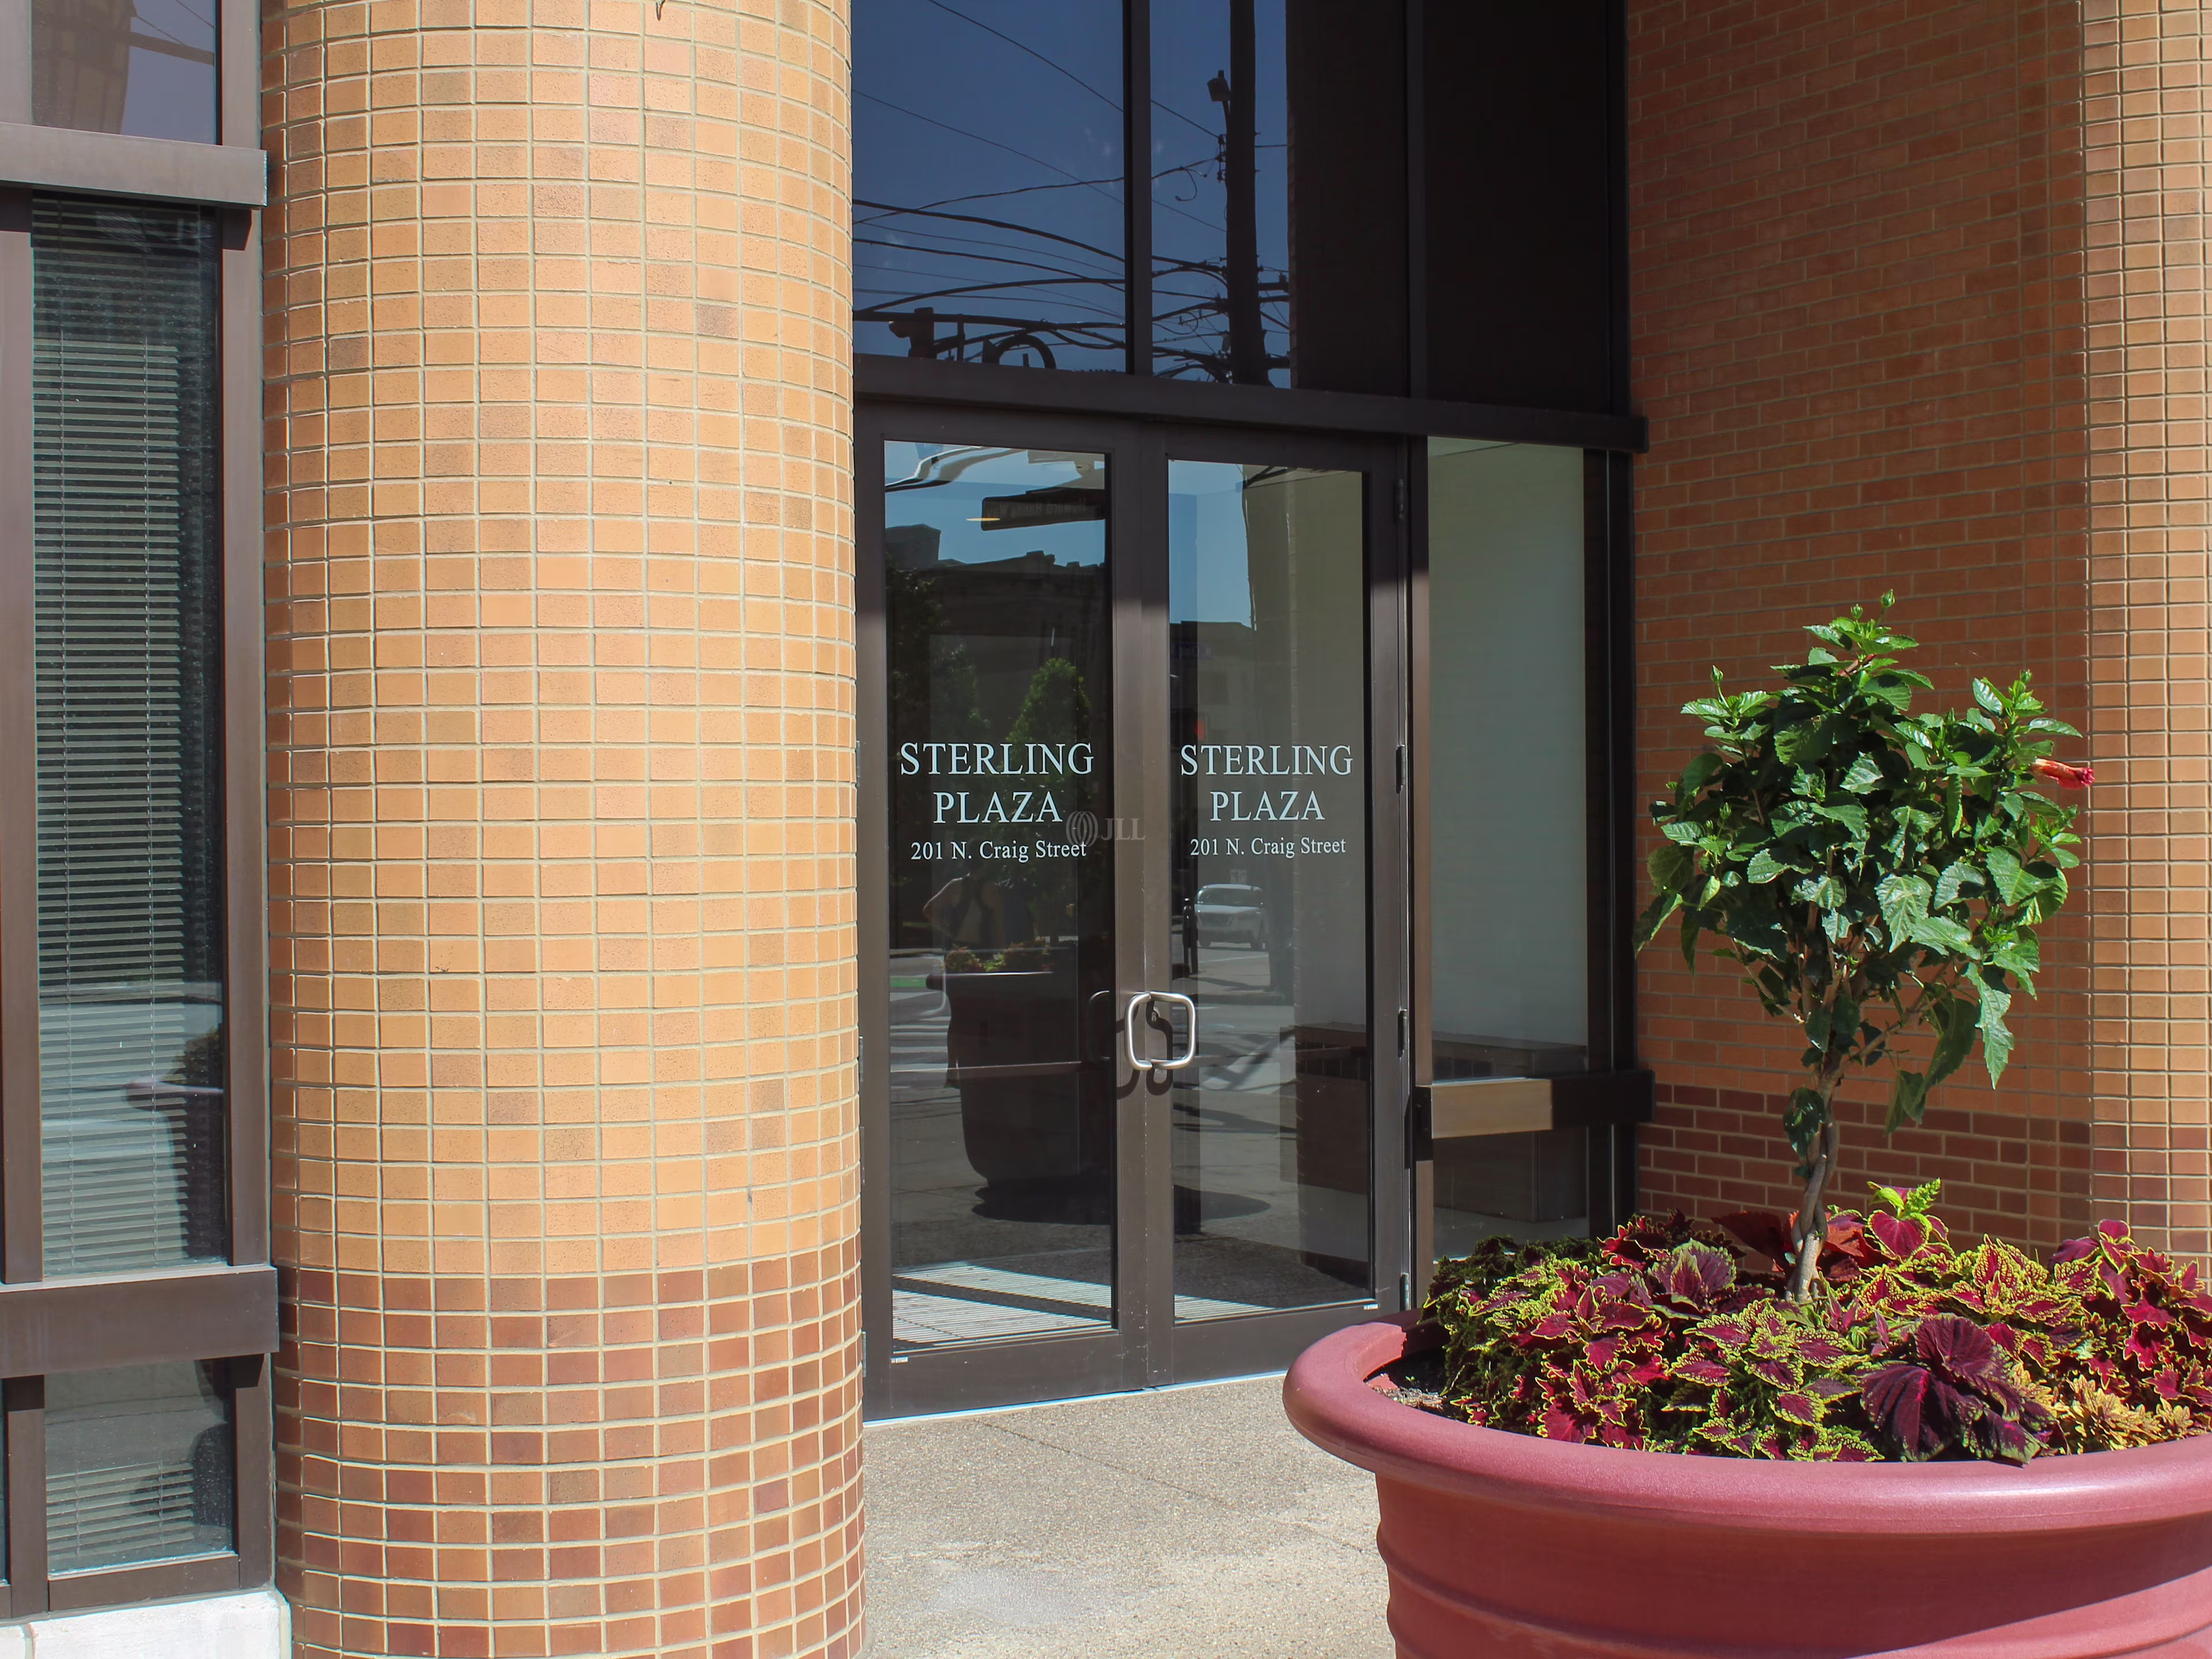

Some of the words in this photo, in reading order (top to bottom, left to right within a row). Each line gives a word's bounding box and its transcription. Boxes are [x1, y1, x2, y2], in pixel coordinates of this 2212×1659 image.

[901, 743, 1094, 775] STERLING
[1181, 744, 1354, 776] STERLING
[933, 791, 1063, 824] PLAZA
[1210, 790, 1326, 822] PLAZA
[911, 842, 943, 861] 201
[950, 841, 973, 860] N.
[979, 840, 1029, 863] Craig
[1036, 840, 1087, 859] Street
[1190, 838, 1219, 856] 201
[1225, 838, 1245, 856] N.
[1251, 836, 1296, 859] Craig
[1301, 836, 1347, 855] Street
